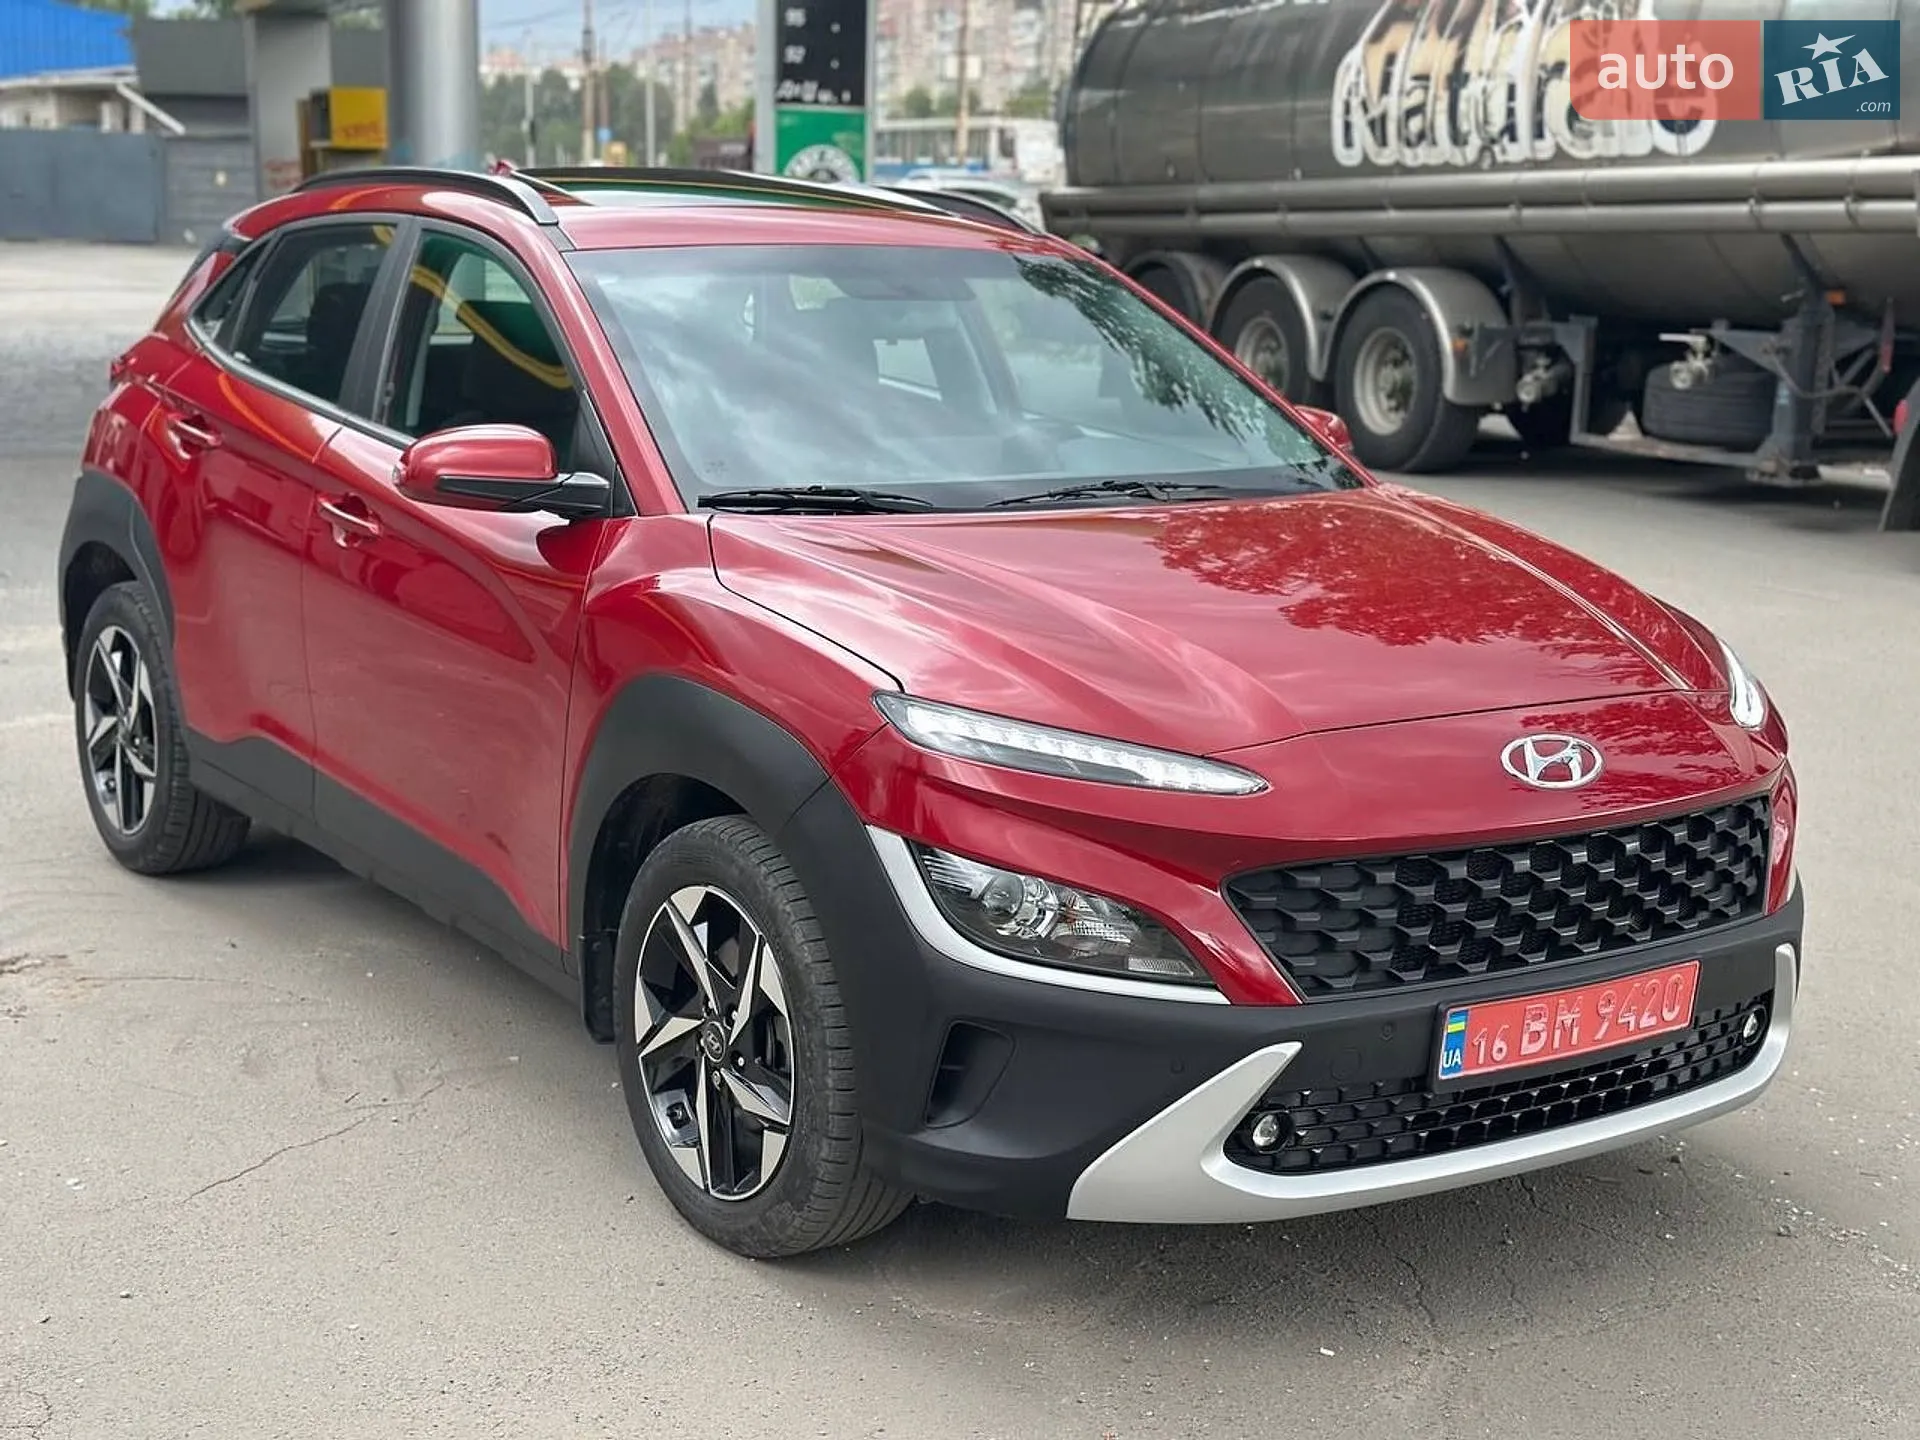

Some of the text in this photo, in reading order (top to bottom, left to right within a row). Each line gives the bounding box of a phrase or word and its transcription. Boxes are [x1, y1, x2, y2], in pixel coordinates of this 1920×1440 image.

[1473, 973, 1685, 1065] 16 BM 9420
[1442, 1050, 1462, 1069] UA
